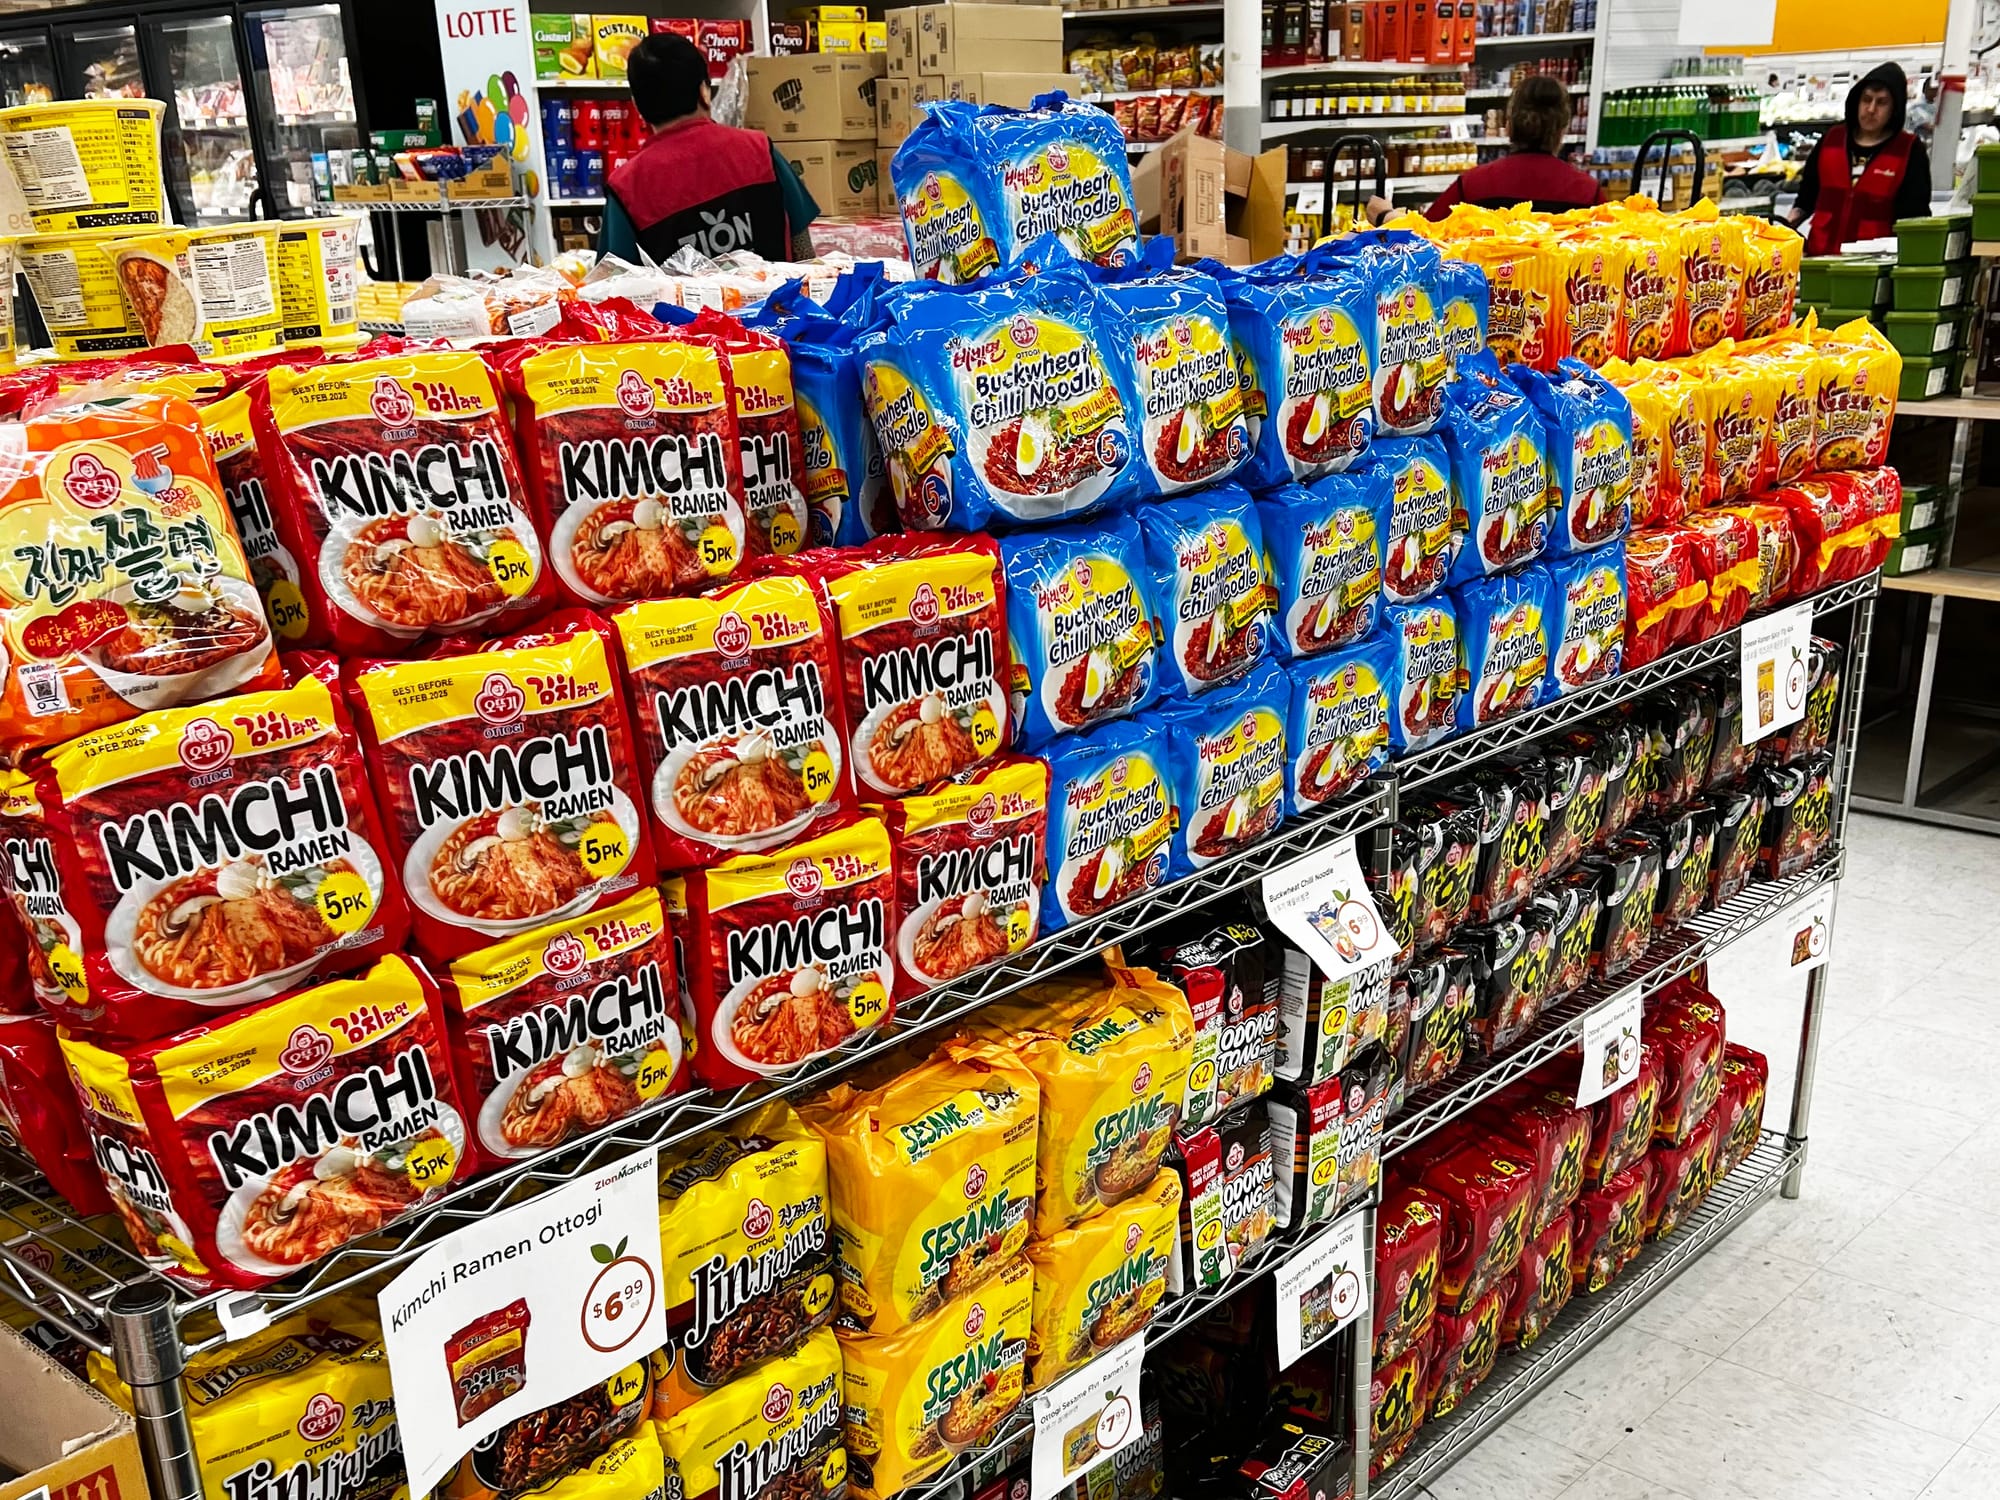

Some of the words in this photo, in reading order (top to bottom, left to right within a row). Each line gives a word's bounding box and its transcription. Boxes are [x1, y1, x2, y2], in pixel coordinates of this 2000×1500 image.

[447, 8, 517, 38] LOTTE
[535, 31, 571, 42] Custard
[705, 33, 739, 47] Choco
[708, 48, 726, 62] Pie
[772, 34, 802, 46] Choco
[1020, 172, 1112, 214] Buckwheat
[913, 203, 973, 243] Buckwheat
[1015, 209, 1060, 243] Chilli
[1060, 191, 1120, 228] Noodle
[679, 211, 753, 258] ZION
[914, 240, 940, 266] Chilli
[938, 221, 980, 255] Noodle
[1385, 318, 1435, 344] Buckwheat
[1293, 341, 1362, 371] Buckwheat
[1407, 338, 1441, 360] Noodle
[975, 344, 1091, 397] Buckwheat
[1151, 347, 1229, 391] Buckwheat
[1286, 371, 1321, 397] Chilli
[1321, 362, 1366, 388] Noodle
[292, 384, 316, 397] BEST
[317, 381, 352, 392] BEFORE
[969, 387, 1024, 428] Chilli
[1029, 368, 1104, 406] Noodle
[1146, 386, 1185, 418] Chilli
[1188, 367, 1237, 399] Noodle
[381, 428, 418, 441] OTTOGI
[314, 441, 509, 520] KIMCHI
[561, 433, 726, 502] KIMCHI
[671, 492, 729, 517] RAMEN
[751, 483, 792, 508] RAMEN
[448, 503, 515, 533] RAMEN
[495, 555, 531, 581] 5PK
[703, 541, 734, 563] 5PK
[1190, 548, 1252, 594] Buckwheat
[1054, 581, 1134, 637] Buckwheat
[1179, 591, 1217, 621] Chilli
[1216, 568, 1259, 600] Noodle
[645, 629, 665, 640] BEST
[666, 623, 698, 634] BEFORE
[1050, 632, 1093, 667] Chilli
[1093, 604, 1139, 647] Noodle
[864, 629, 993, 710] KIMCHI
[392, 686, 416, 697] BEST
[417, 678, 455, 692] BEFORE
[398, 690, 448, 707] 13.FEB.2025
[946, 680, 993, 709] RAMEN
[484, 694, 519, 715] 오뚜기
[657, 661, 824, 749] KIMCHI
[1316, 688, 1382, 725] Buckwheat
[484, 724, 525, 739] OTTOGI
[773, 717, 825, 748] RAMEN
[975, 723, 997, 745] 5PK
[1307, 724, 1340, 747] Chilli
[1339, 707, 1387, 735] Noodle
[190, 741, 226, 761] 오뚜기
[1211, 731, 1284, 784] Buckwheat
[189, 768, 234, 788] OTTOGI
[411, 726, 611, 827] KIMCHI
[806, 766, 831, 790] 5PK
[544, 786, 616, 822] RAMEN
[1078, 775, 1159, 831] Buckwheat
[1200, 783, 1239, 812] Chilli
[102, 766, 347, 890] KIMCHI
[1067, 823, 1111, 860] Chilli
[1112, 801, 1164, 840] Noodle
[268, 830, 351, 876] RAMEN
[586, 838, 624, 865] 5PK
[919, 835, 1034, 903] KIMCHI
[1268, 883, 1301, 903] Buckwheat
[1300, 874, 1315, 888] Chilli
[1314, 866, 1335, 881] Noodle
[325, 890, 368, 920] 5PK
[990, 881, 1031, 905] RAMEN
[729, 899, 882, 984] KIMCHI
[1011, 923, 1027, 943] 5PK
[829, 950, 882, 980] RAMEN
[555, 972, 592, 991] OTTOGI
[489, 962, 663, 1080] KIMCHI
[854, 996, 882, 1018] 5PK
[1326, 1010, 1342, 1030] x2
[605, 1015, 665, 1056] RAMEN
[1219, 1006, 1278, 1051] ODONG
[192, 1062, 216, 1079] BEST
[217, 1047, 258, 1068] BEFORE
[289, 1044, 326, 1065] 오뚜기
[1218, 1035, 1264, 1077] TONG
[294, 1066, 335, 1090] OTTOGI
[640, 1065, 668, 1089] 5PK
[1193, 1066, 1211, 1087] x2
[212, 1046, 434, 1189] KIMCHI
[363, 1103, 439, 1153] RAMEN
[1087, 1091, 1165, 1157] SESAME
[1341, 1102, 1385, 1144] ODONG
[413, 1149, 449, 1181] 5PK
[1337, 1131, 1372, 1171] TONG
[1224, 1160, 1274, 1203] ODONG
[1316, 1162, 1333, 1181] x2
[127, 1184, 172, 1213] RAMEN
[1007, 1198, 1029, 1220] FLAVOR
[1223, 1193, 1265, 1229] TONG
[746, 1233, 777, 1253] OTTOGI
[919, 1187, 1010, 1273] SESAME
[1199, 1224, 1218, 1245] x2
[390, 1271, 447, 1333] Kimchi
[452, 1238, 532, 1285] Ramen
[538, 1198, 603, 1245] Ottogi
[1082, 1246, 1157, 1317] SESAME
[1002, 1341, 1027, 1362] FLAVOR
[922, 1328, 1005, 1412] SESAME
[1040, 1407, 1062, 1426] Ottogi
[1061, 1389, 1088, 1412] Sesame
[1102, 1365, 1125, 1383] Ramen
[307, 1413, 339, 1435] 오뚜기
[767, 1415, 795, 1437] OTTOGI
[304, 1436, 345, 1458] OTTOGI
[1115, 1420, 1163, 1469] ODONG
